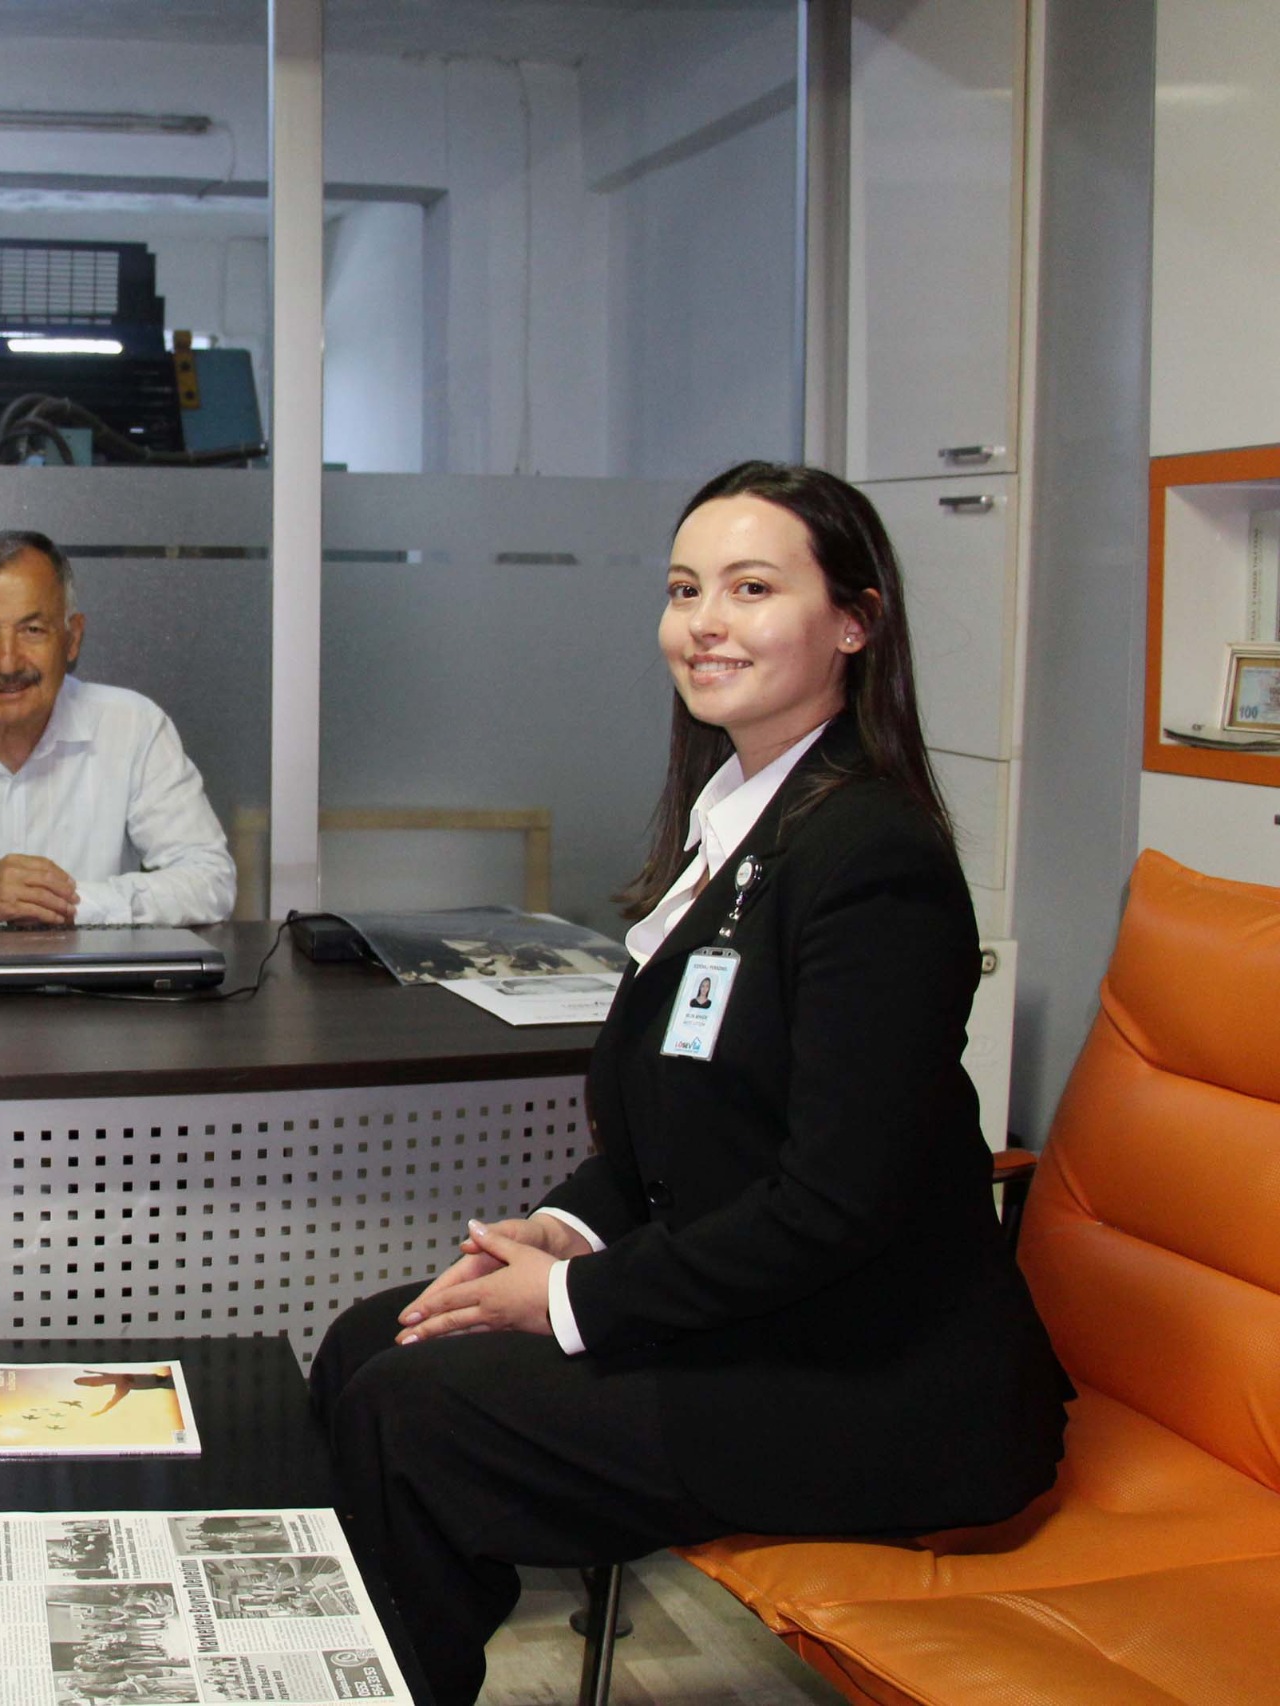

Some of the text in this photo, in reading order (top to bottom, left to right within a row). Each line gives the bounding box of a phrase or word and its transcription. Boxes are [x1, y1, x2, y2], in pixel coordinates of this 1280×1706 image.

[1239, 705, 1258, 719] 100
[180, 1560, 220, 1653] Marketlere Bayram Denetimi
